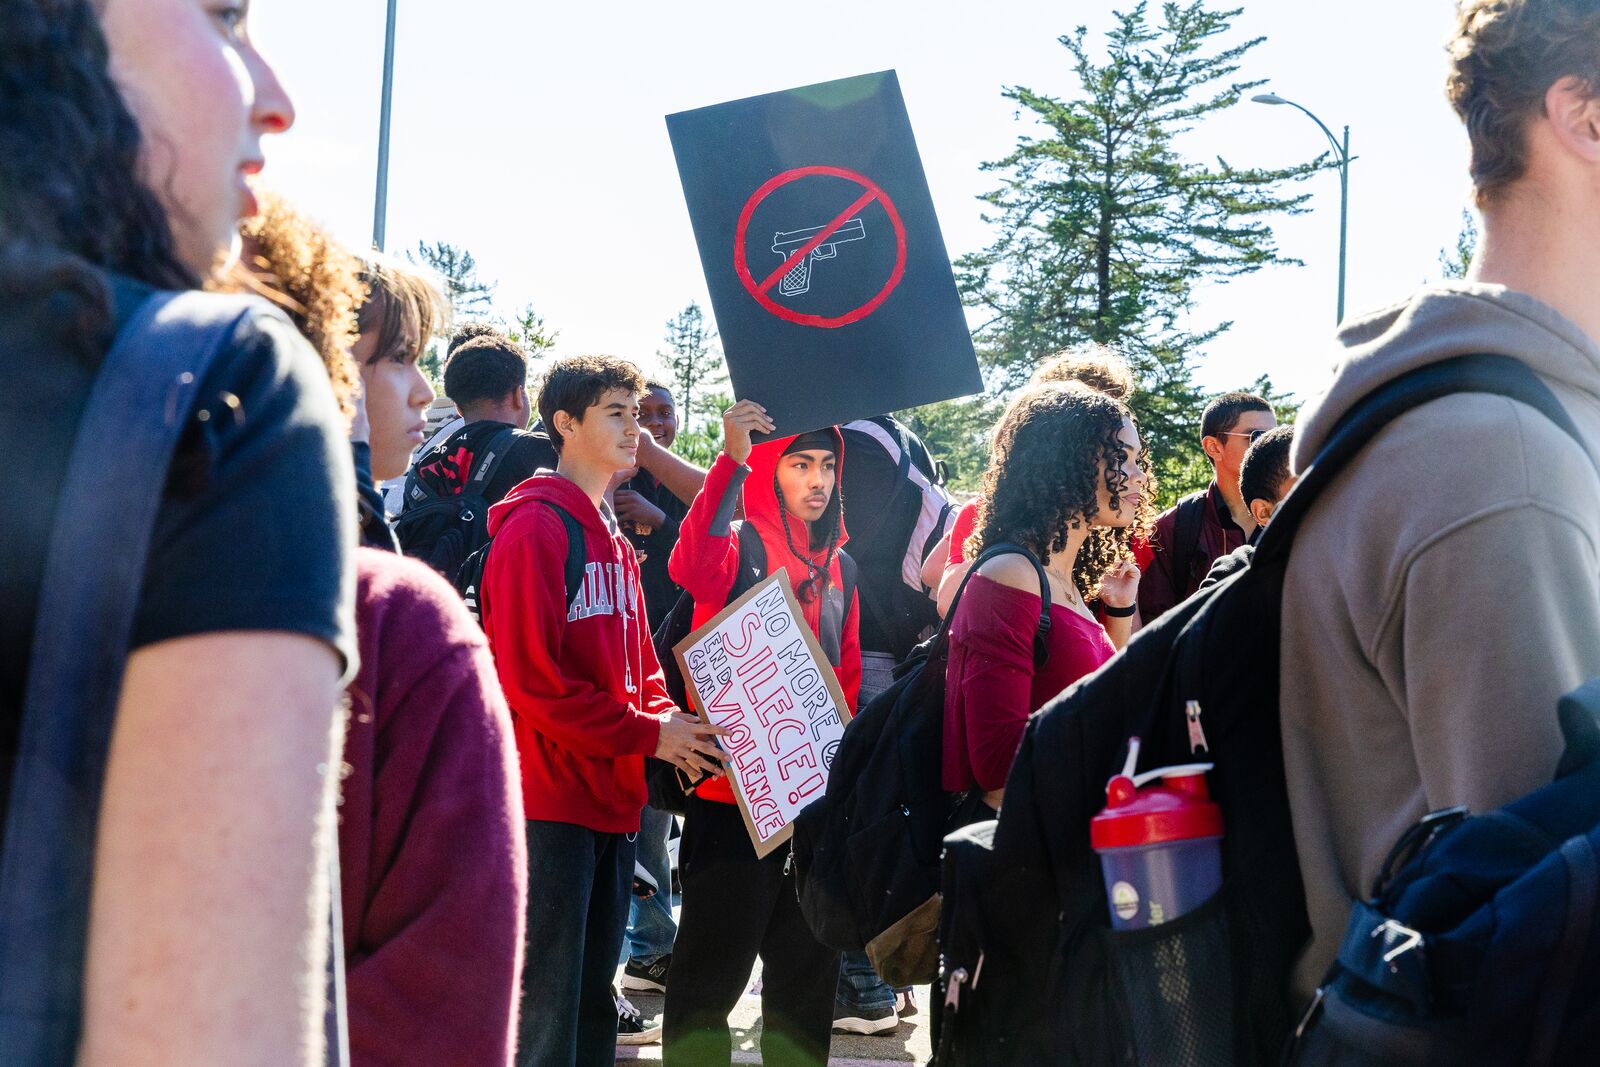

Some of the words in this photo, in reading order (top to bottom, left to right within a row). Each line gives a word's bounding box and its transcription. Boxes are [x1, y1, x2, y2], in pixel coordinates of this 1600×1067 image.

[688, 649, 716, 701] GUN
[703, 632, 732, 685] END
[722, 612, 825, 805] SILECE!
[755, 586, 791, 637] NO
[777, 639, 839, 742] MORE
[708, 680, 786, 839] VIOLENCE
